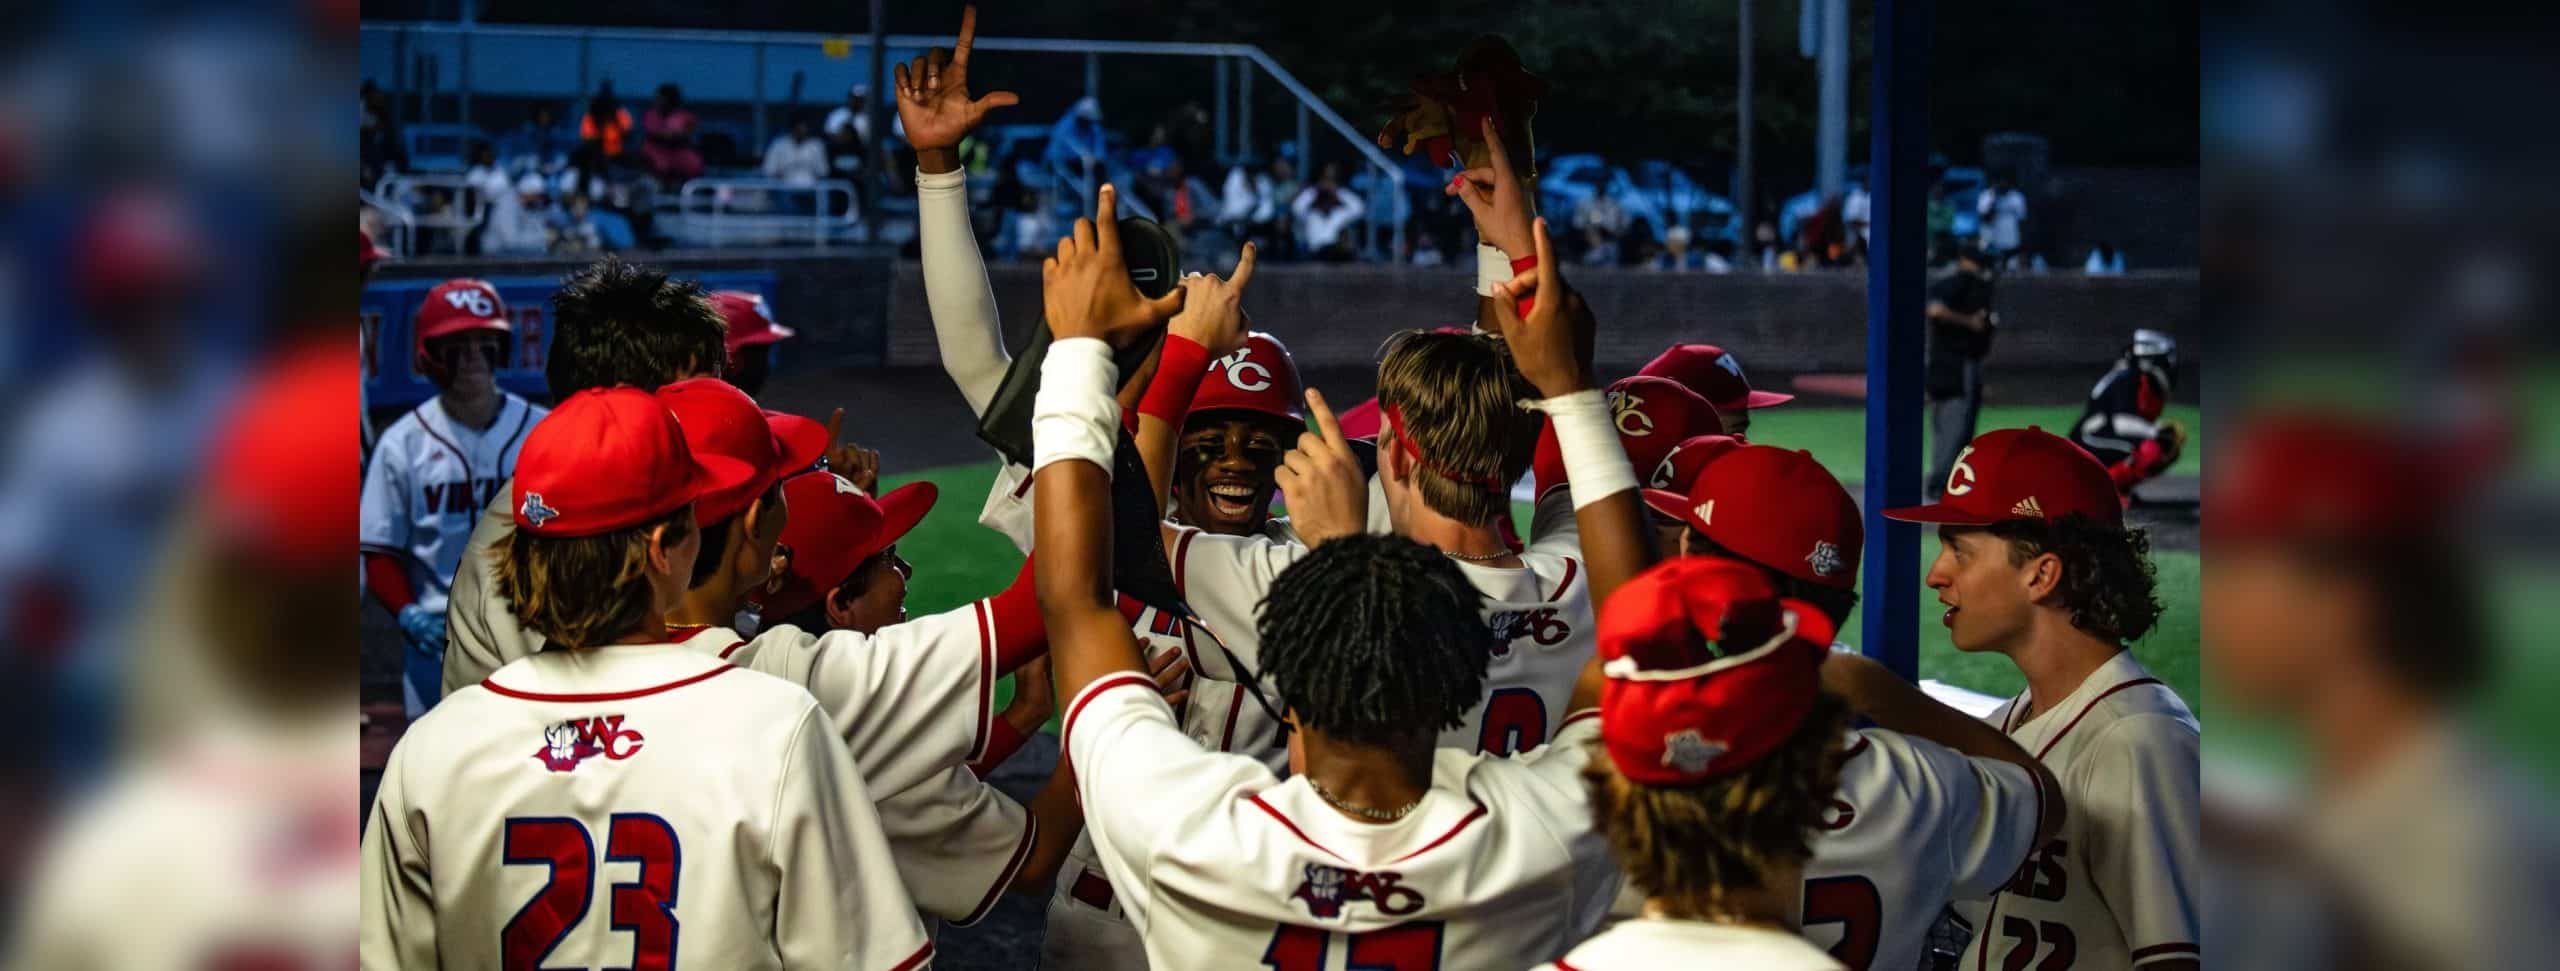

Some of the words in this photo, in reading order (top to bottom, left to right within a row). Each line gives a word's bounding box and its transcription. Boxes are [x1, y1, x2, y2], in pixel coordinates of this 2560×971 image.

[445, 288, 493, 317] WC
[567, 713, 645, 760] WC
[502, 812, 681, 971] 23
[1341, 868, 1425, 916] WC
